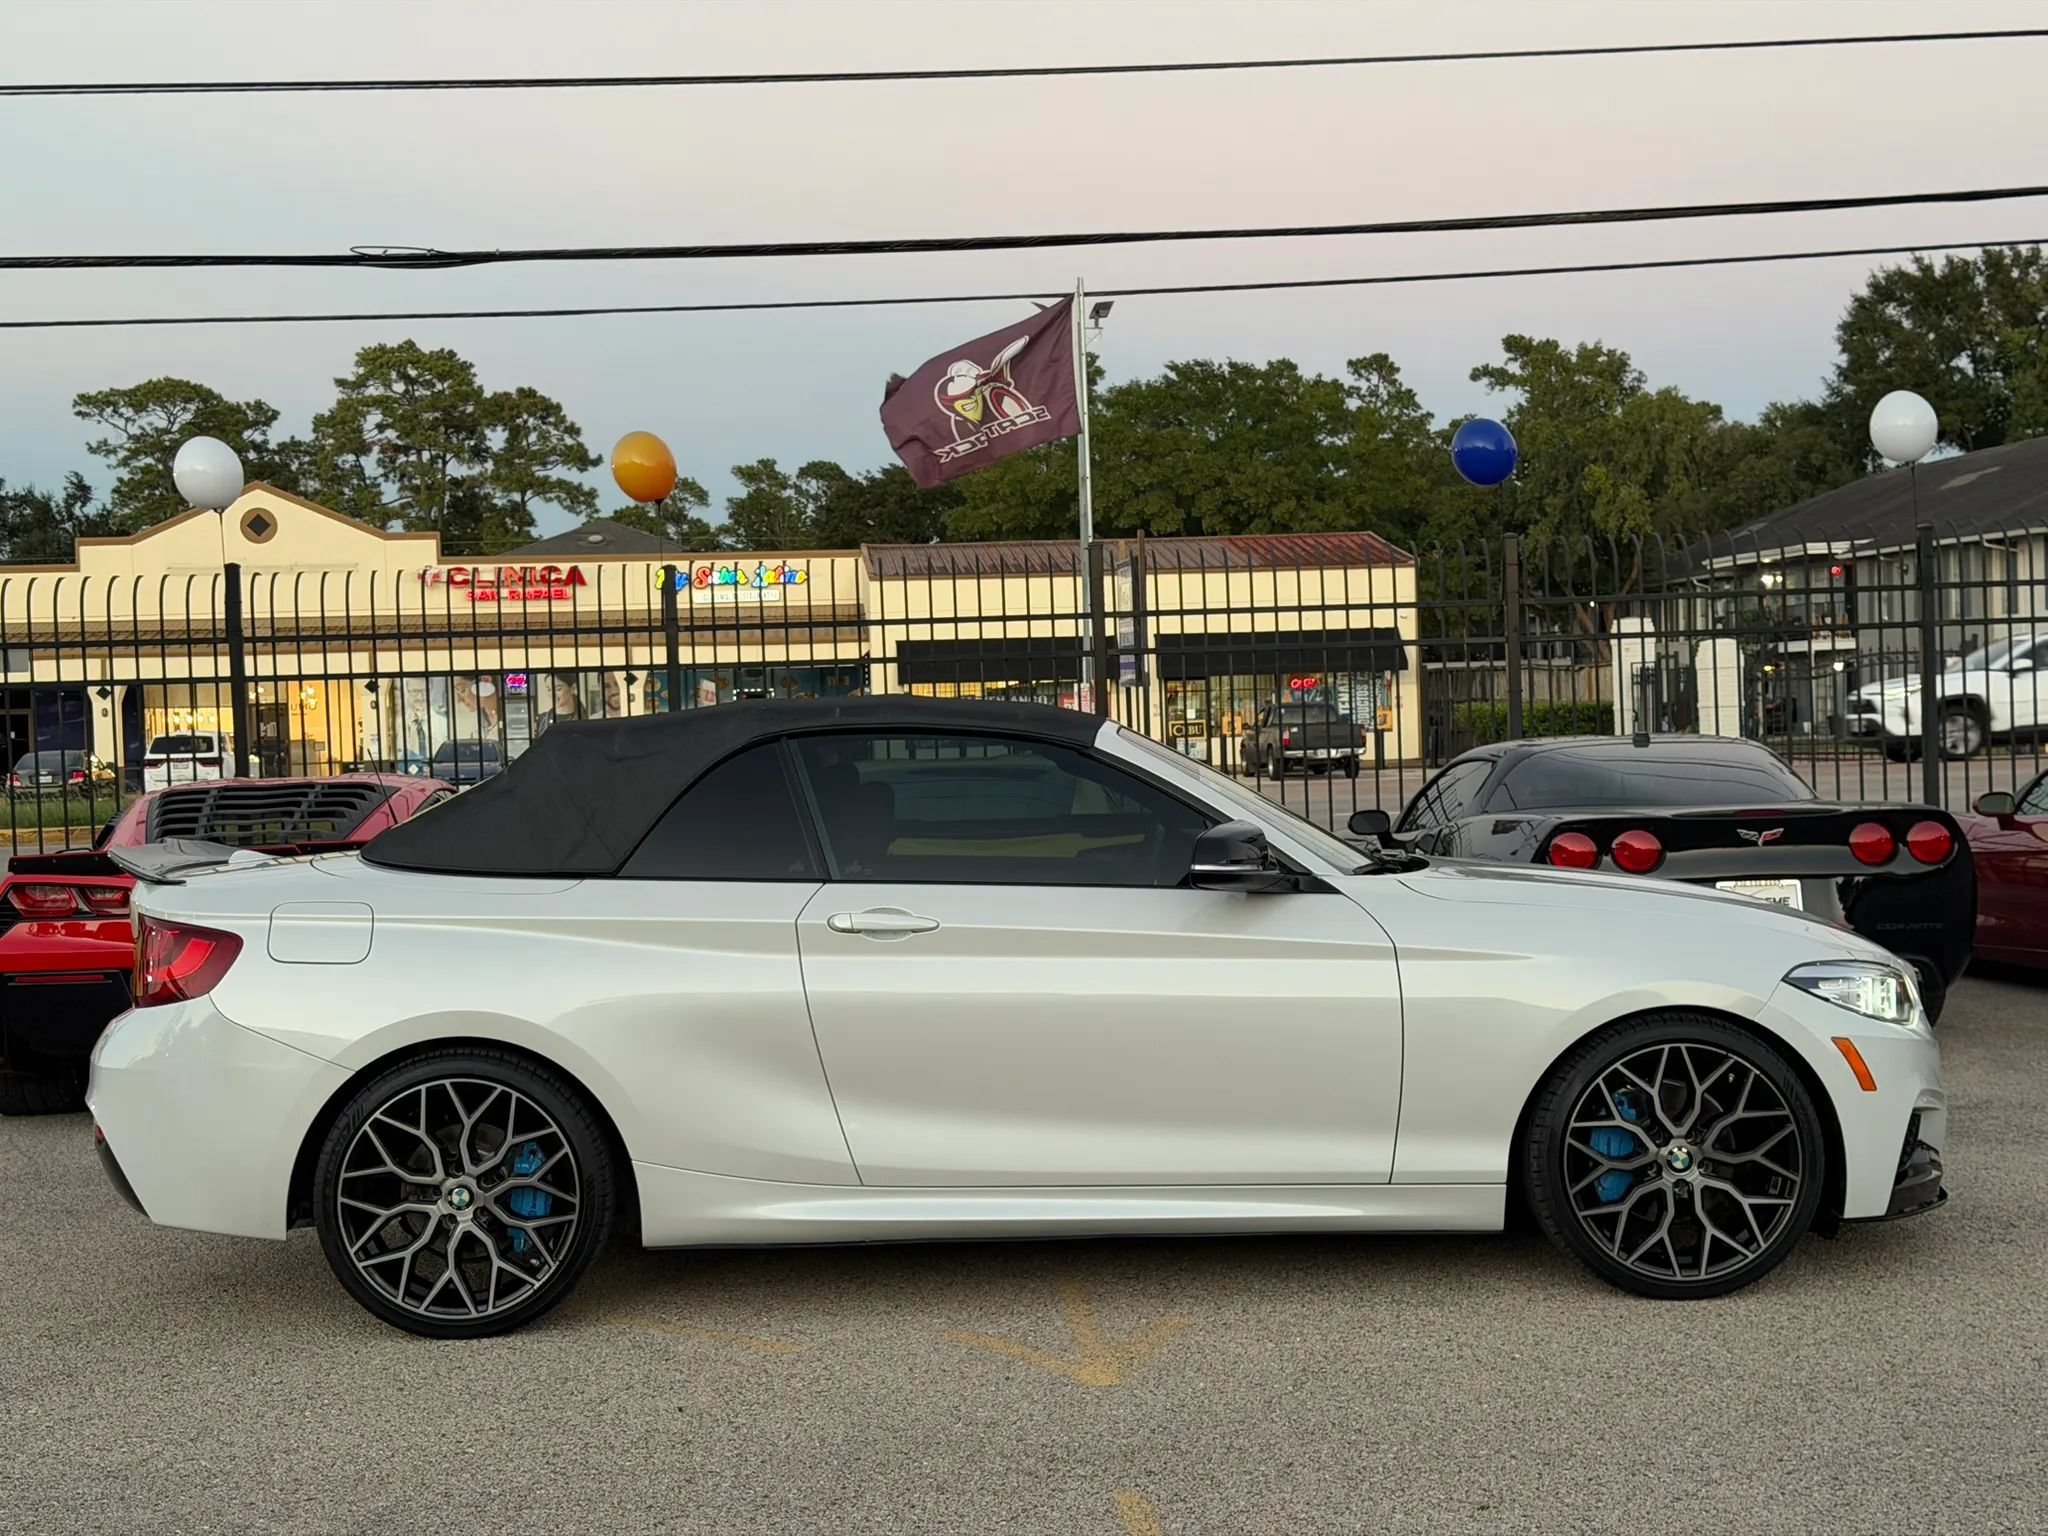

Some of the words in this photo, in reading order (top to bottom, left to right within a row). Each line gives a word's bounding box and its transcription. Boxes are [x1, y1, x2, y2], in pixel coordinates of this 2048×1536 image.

[449, 565, 587, 588] CLINICA
[465, 589, 499, 602] SAN
[508, 588, 572, 602] RAFAEL
